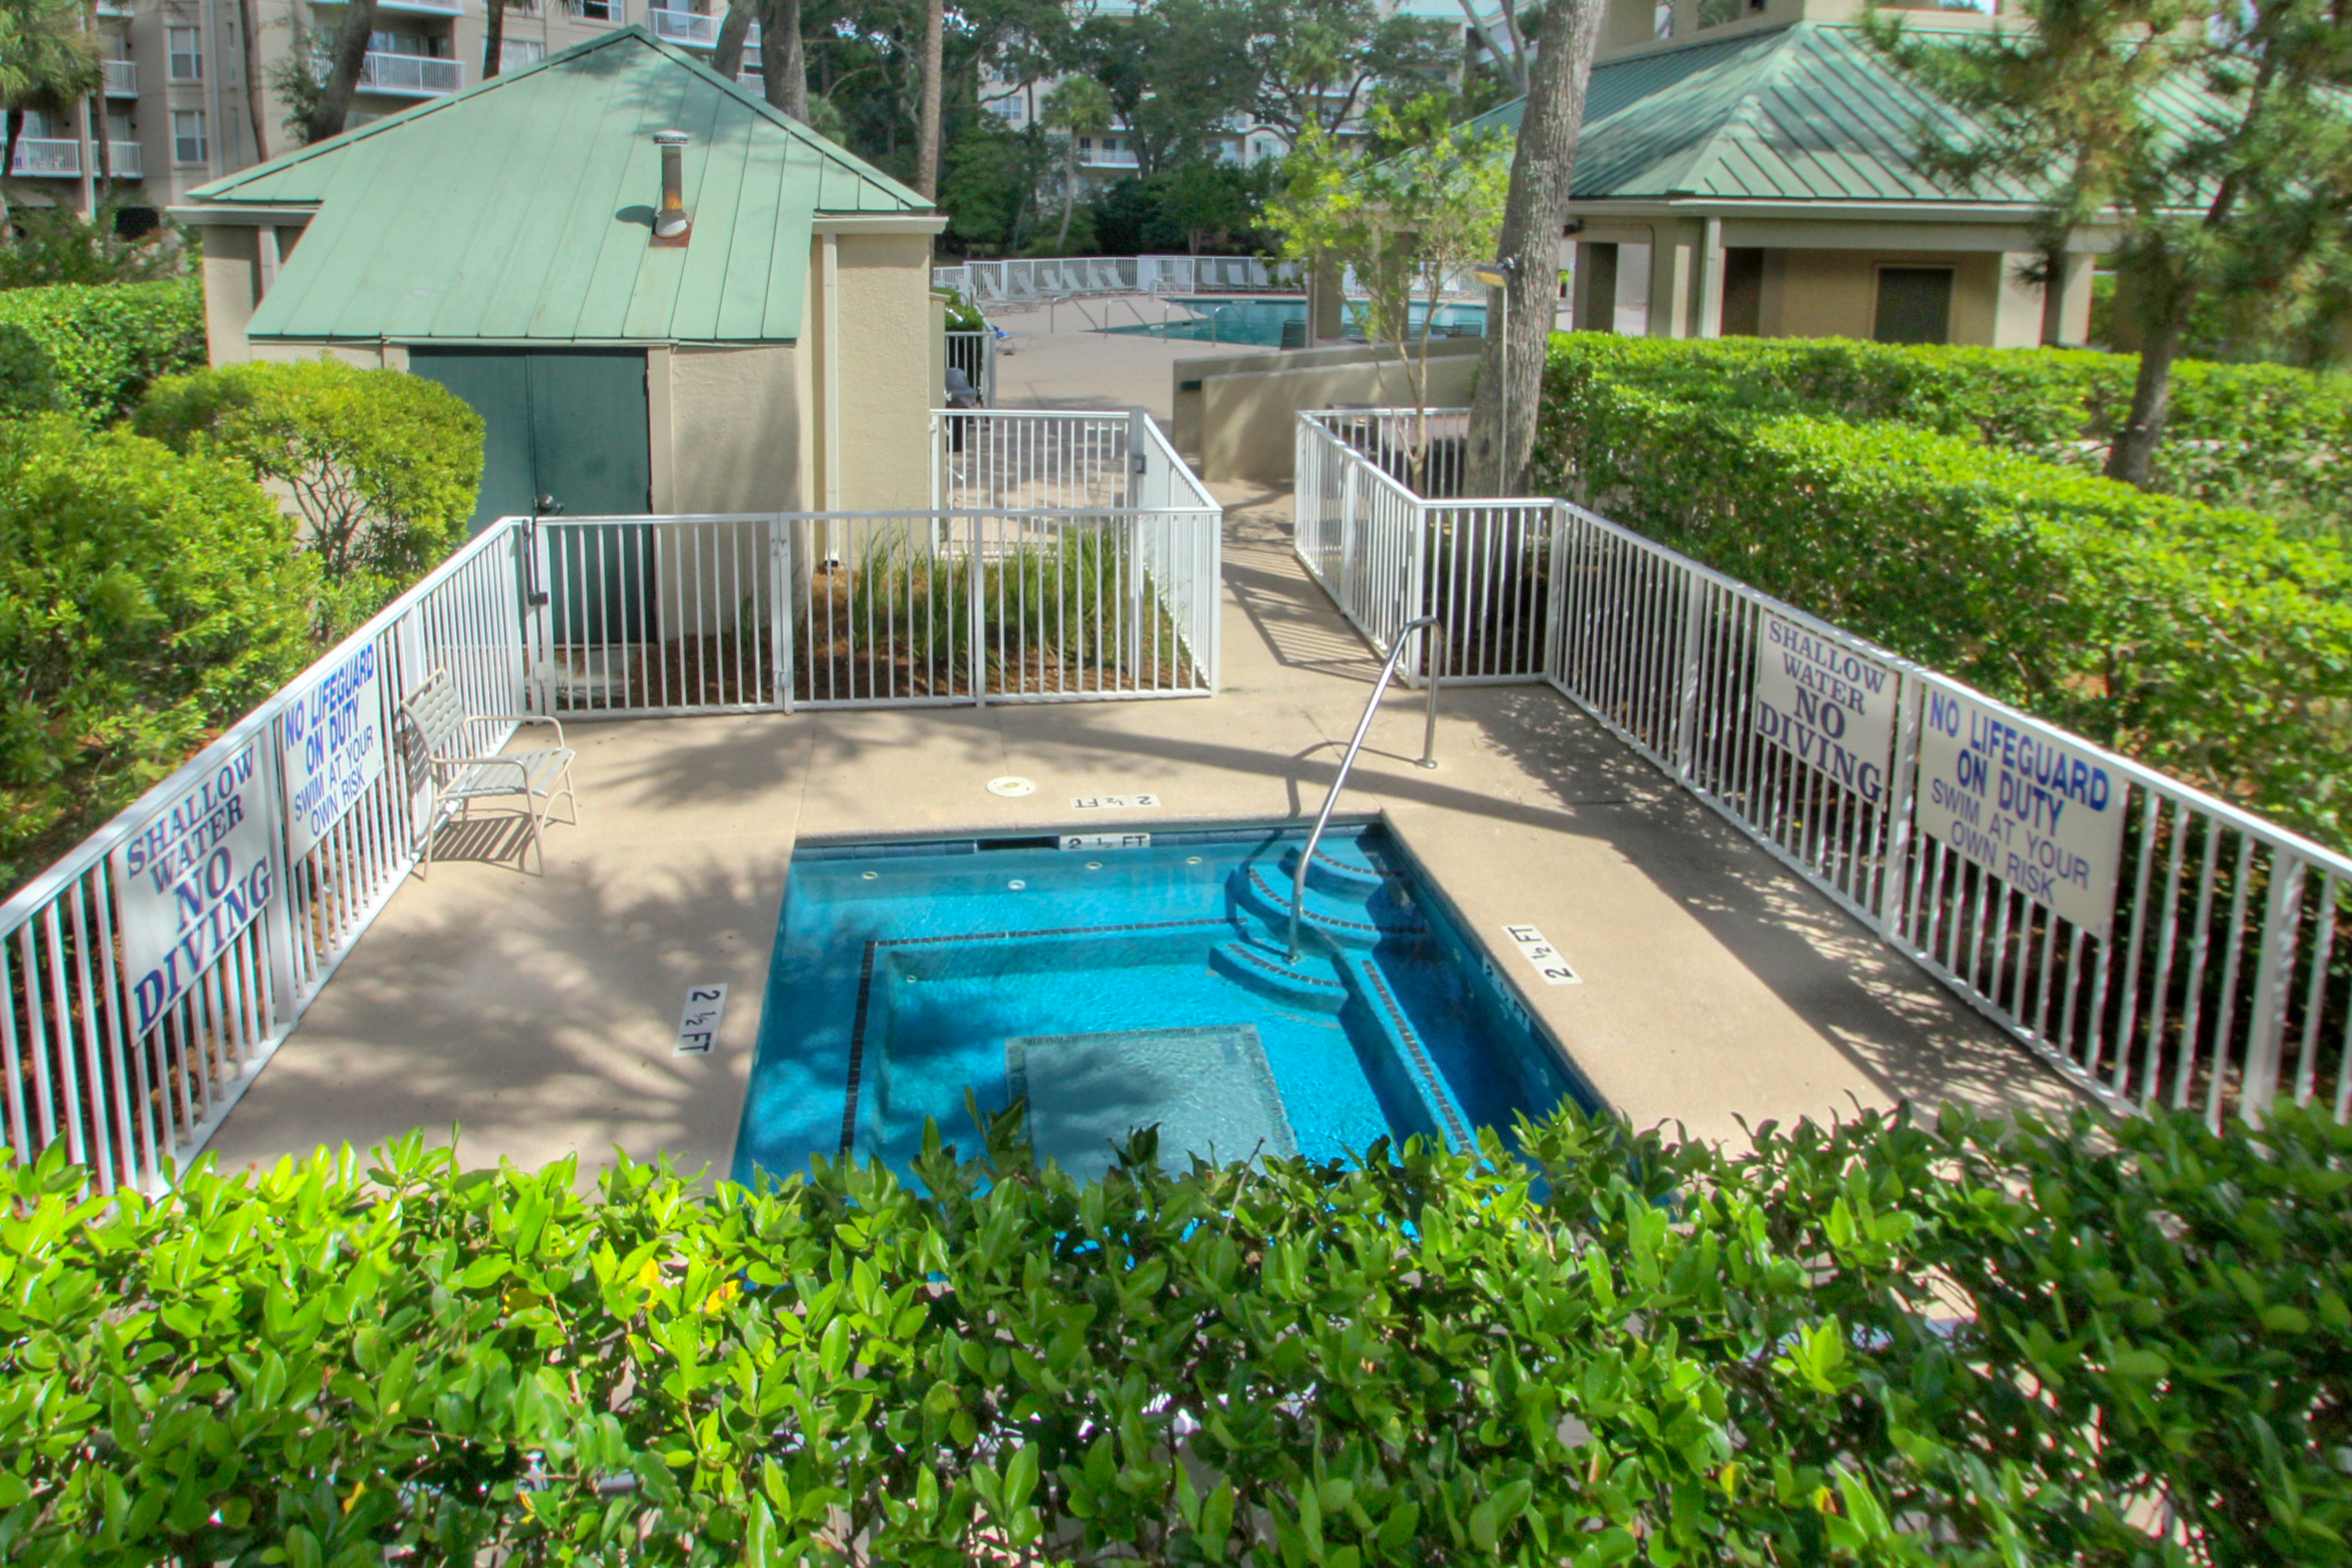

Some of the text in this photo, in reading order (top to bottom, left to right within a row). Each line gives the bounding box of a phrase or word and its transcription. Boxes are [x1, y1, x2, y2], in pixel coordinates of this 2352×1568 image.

[285, 643, 375, 752] NO LIFEGUARD
[1768, 620, 1886, 694] SHALLOW
[1783, 651, 1866, 716] WATER
[306, 693, 360, 777] ON DUTY
[1758, 700, 1882, 803] DIVING
[1794, 684, 1845, 740] NO
[1929, 691, 2110, 812] NO LIFEGUARD
[127, 742, 254, 880] SHALLOW
[294, 724, 374, 823] SWIM AT YOUR
[311, 761, 365, 837] OWN RISK
[1075, 798, 1099, 808] FT
[1137, 796, 1151, 805] 2
[1957, 748, 2065, 838] ON DUTY
[150, 794, 245, 894] WATER
[1069, 838, 1082, 849] 2
[1123, 835, 1146, 847] FT
[1932, 777, 2091, 891] SWIM AT YOUR
[1951, 820, 2057, 905] OWN RISK
[173, 846, 233, 935] NO
[133, 855, 272, 1035] DIVING
[1508, 927, 1542, 943] FT
[1544, 968, 1573, 978] 2
[692, 990, 721, 1001] 2
[679, 1032, 712, 1052] FT
